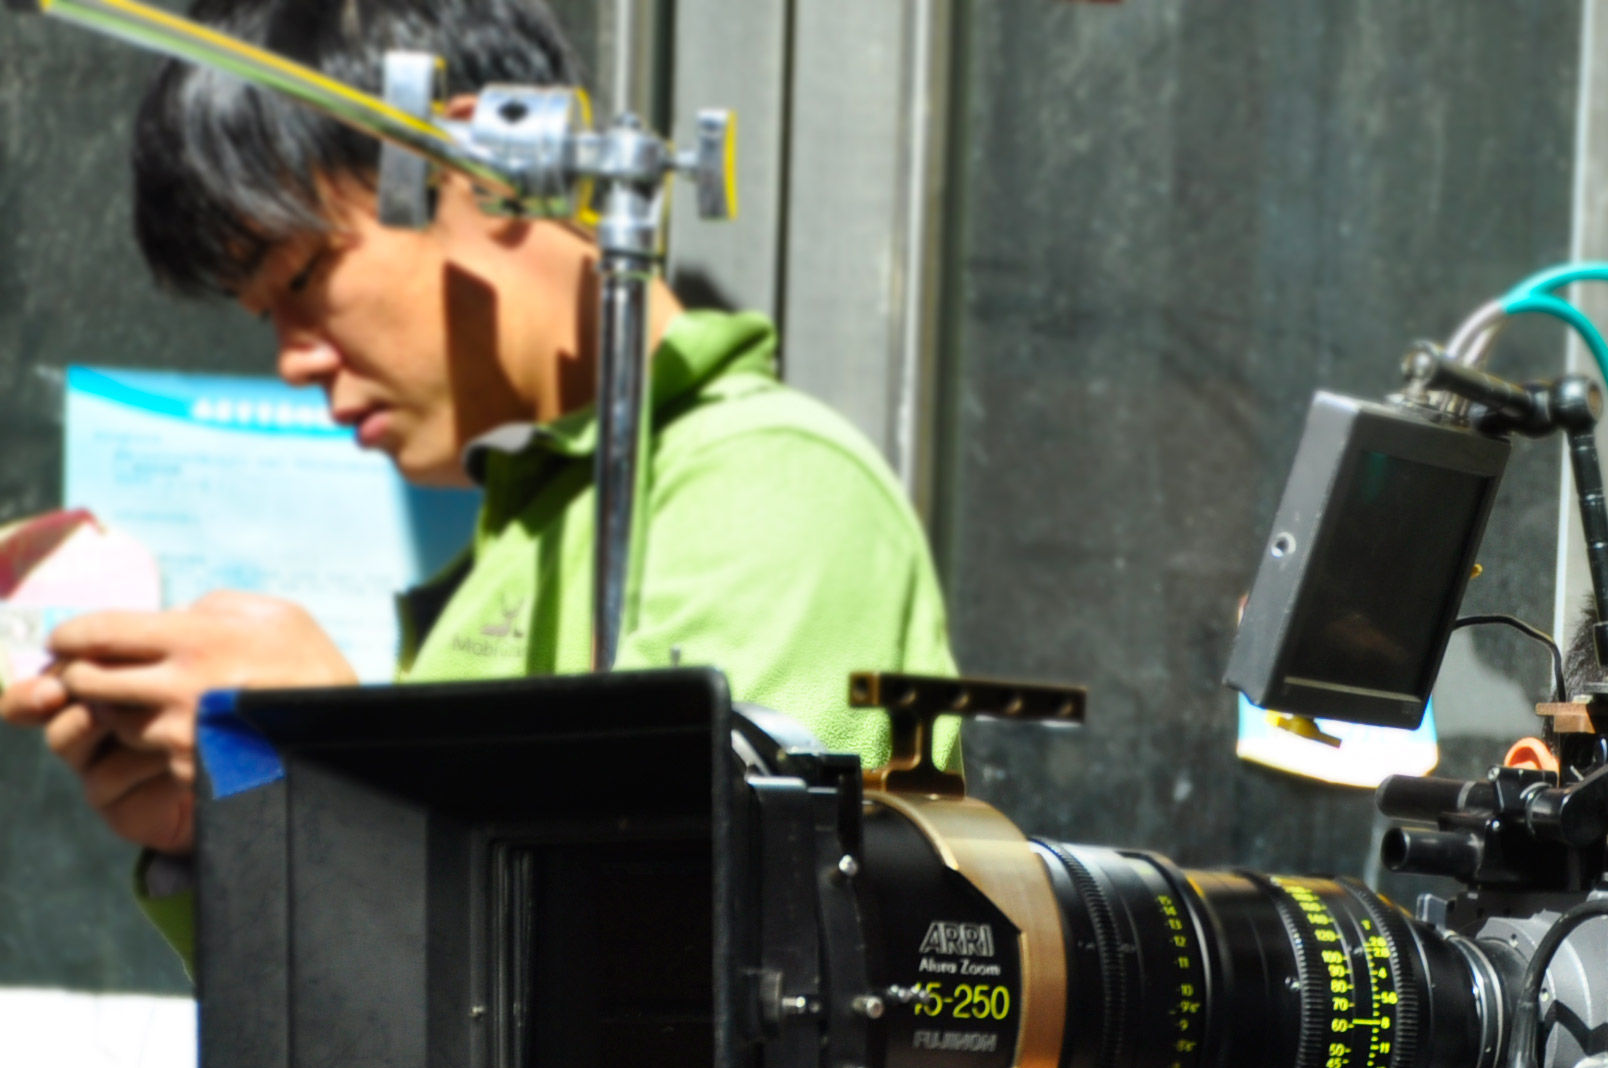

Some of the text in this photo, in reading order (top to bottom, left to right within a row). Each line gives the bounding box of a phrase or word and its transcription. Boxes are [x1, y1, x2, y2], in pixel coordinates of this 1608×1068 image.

[918, 920, 995, 957] ARRI
[1314, 929, 1336, 942] 120
[1321, 950, 1343, 964] 100
[960, 959, 1001, 976] Zoom
[1329, 965, 1345, 977] 90
[1331, 980, 1347, 993] 80
[1332, 997, 1348, 1011] 70
[1332, 1019, 1348, 1032] 60
[1381, 1017, 1390, 1029] 8
[1329, 1043, 1345, 1057] 50
[1380, 1042, 1390, 1054] 11
